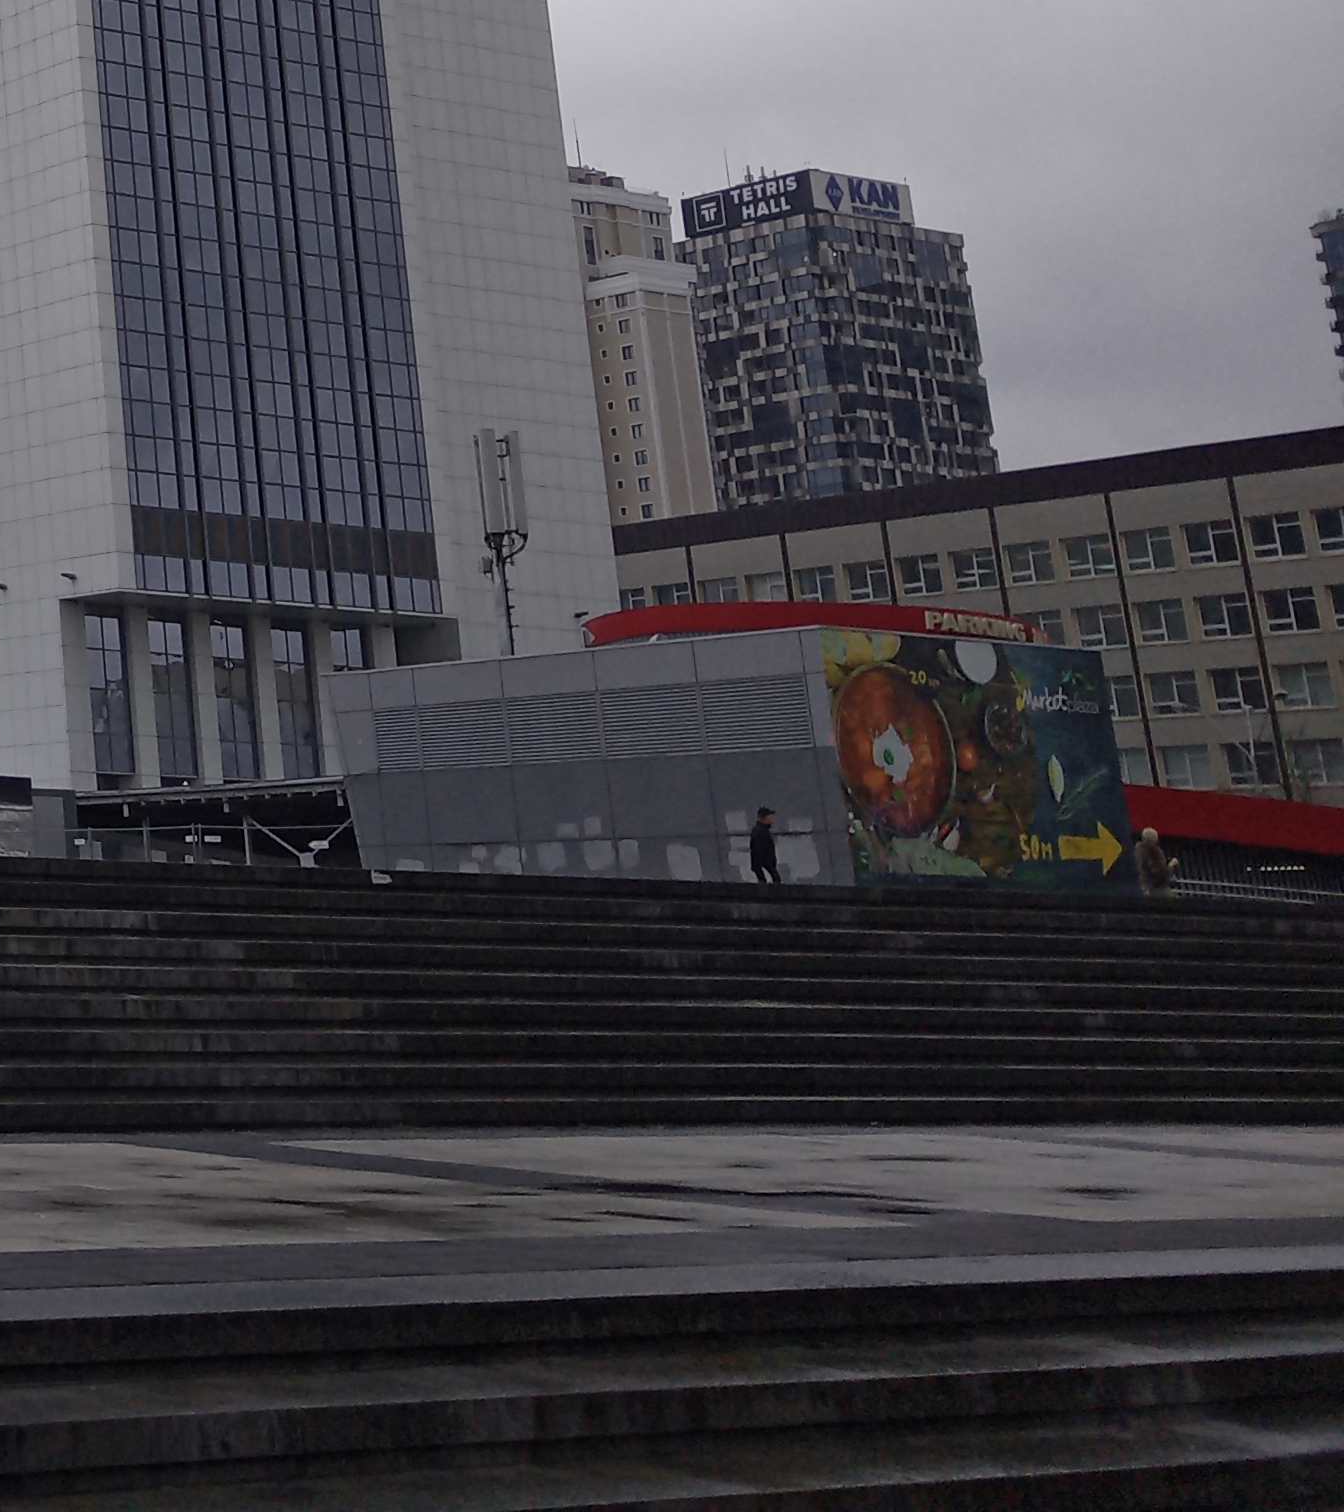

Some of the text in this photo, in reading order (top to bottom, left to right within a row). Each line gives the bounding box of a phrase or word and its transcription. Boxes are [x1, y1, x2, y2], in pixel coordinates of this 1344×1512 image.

[730, 176, 797, 204] TETRIS
[849, 178, 899, 208] KAN
[741, 196, 791, 220] HALL
[925, 611, 1026, 642] PARKING
[909, 670, 927, 685] 20
